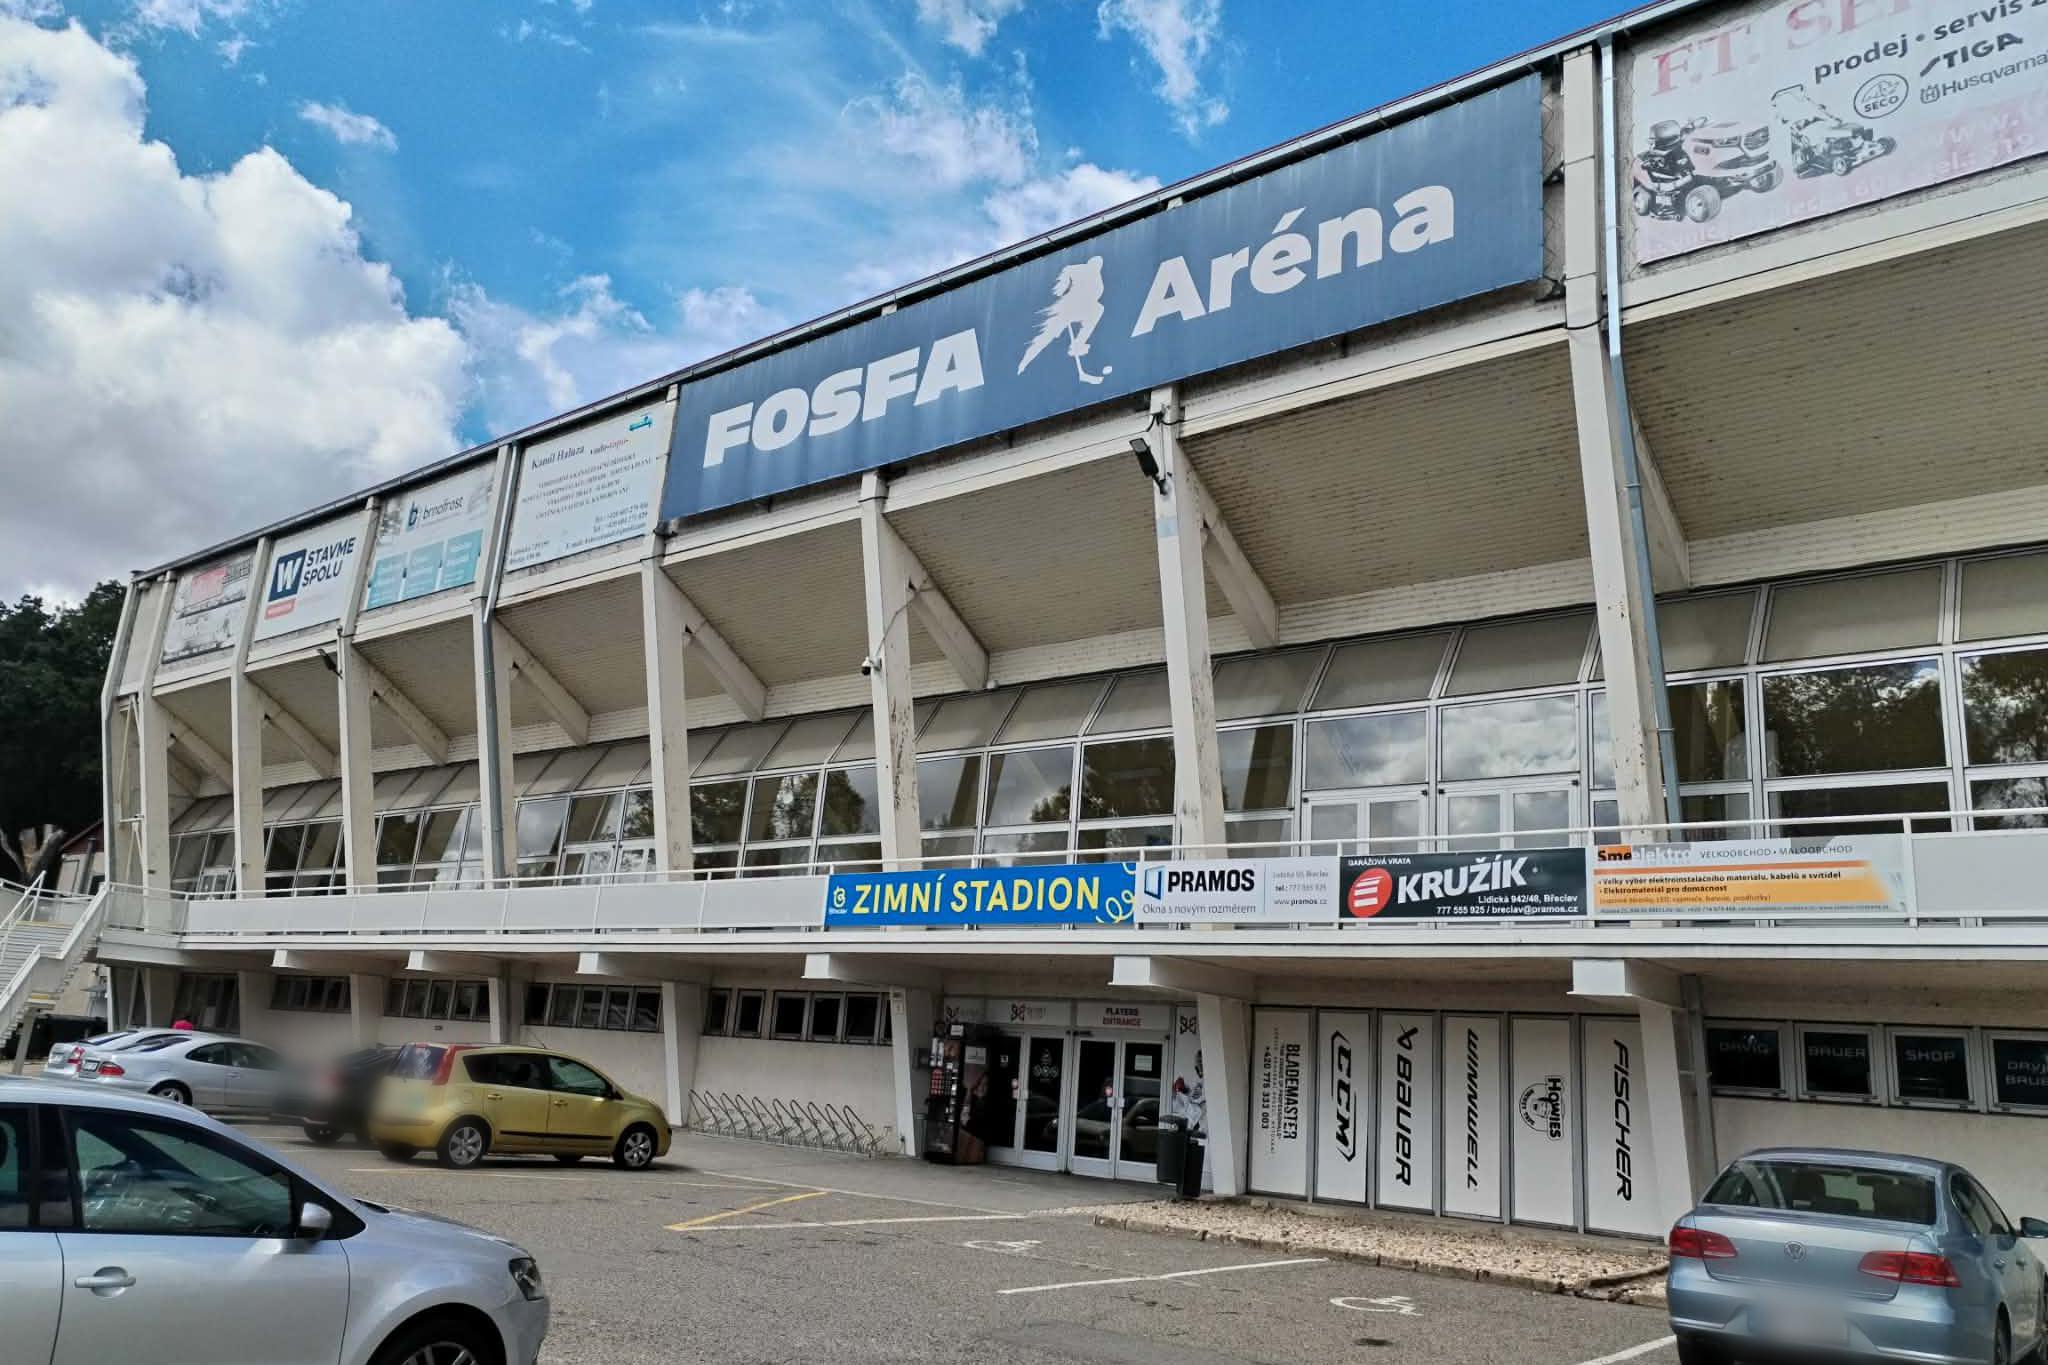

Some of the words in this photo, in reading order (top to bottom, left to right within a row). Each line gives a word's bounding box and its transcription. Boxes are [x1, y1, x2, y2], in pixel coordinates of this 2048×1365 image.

[1815, 34, 1908, 85] prodej
[1934, 0, 2022, 41] servis
[1919, 32, 2023, 77] STIGA
[1942, 53, 2048, 97] Husqvarna
[1863, 95, 1899, 113] SECO
[702, 327, 985, 468] FOSFA
[1131, 185, 1455, 338] Aréna
[306, 537, 356, 567] STAVME
[302, 560, 343, 587] SPOLU
[1387, 857, 1411, 865] VRATA
[1701, 849, 1771, 859] VELKOOBCHOD
[1167, 869, 1255, 893] PRAMOS
[1397, 854, 1529, 904] KRUŽÍK
[1666, 886, 1680, 895] pro
[1681, 885, 1727, 893] domácnost
[852, 873, 946, 914] ZIMNÍ
[951, 877, 1100, 913] STADION
[1273, 899, 1328, 907] www.pramos.cz
[1478, 895, 1509, 904] Lidická
[1543, 893, 1578, 903] Břeclav
[1143, 905, 1165, 914] Okna
[1175, 904, 1206, 915] novým
[1208, 904, 1256, 914] rozměrem
[1436, 906, 1451, 914] 777
[1453, 906, 1468, 914] 555
[1470, 906, 1485, 914] 925
[1492, 904, 1579, 916] breclav@pramos.cz
[1105, 1006, 1139, 1017] PLAYERS
[1808, 1045, 1866, 1058] BAUER
[1907, 1050, 1955, 1063] SHOP
[2007, 1061, 2048, 1075] DAVI
[1283, 1043, 1301, 1140] BLADEMASTER
[1336, 1045, 1352, 1147] CCM
[1396, 1058, 1411, 1186] BAUER
[1467, 1028, 1480, 1190] WINNWELL
[1547, 1077, 1562, 1139] HOWIES
[1613, 1039, 1632, 1201] FISCHER
